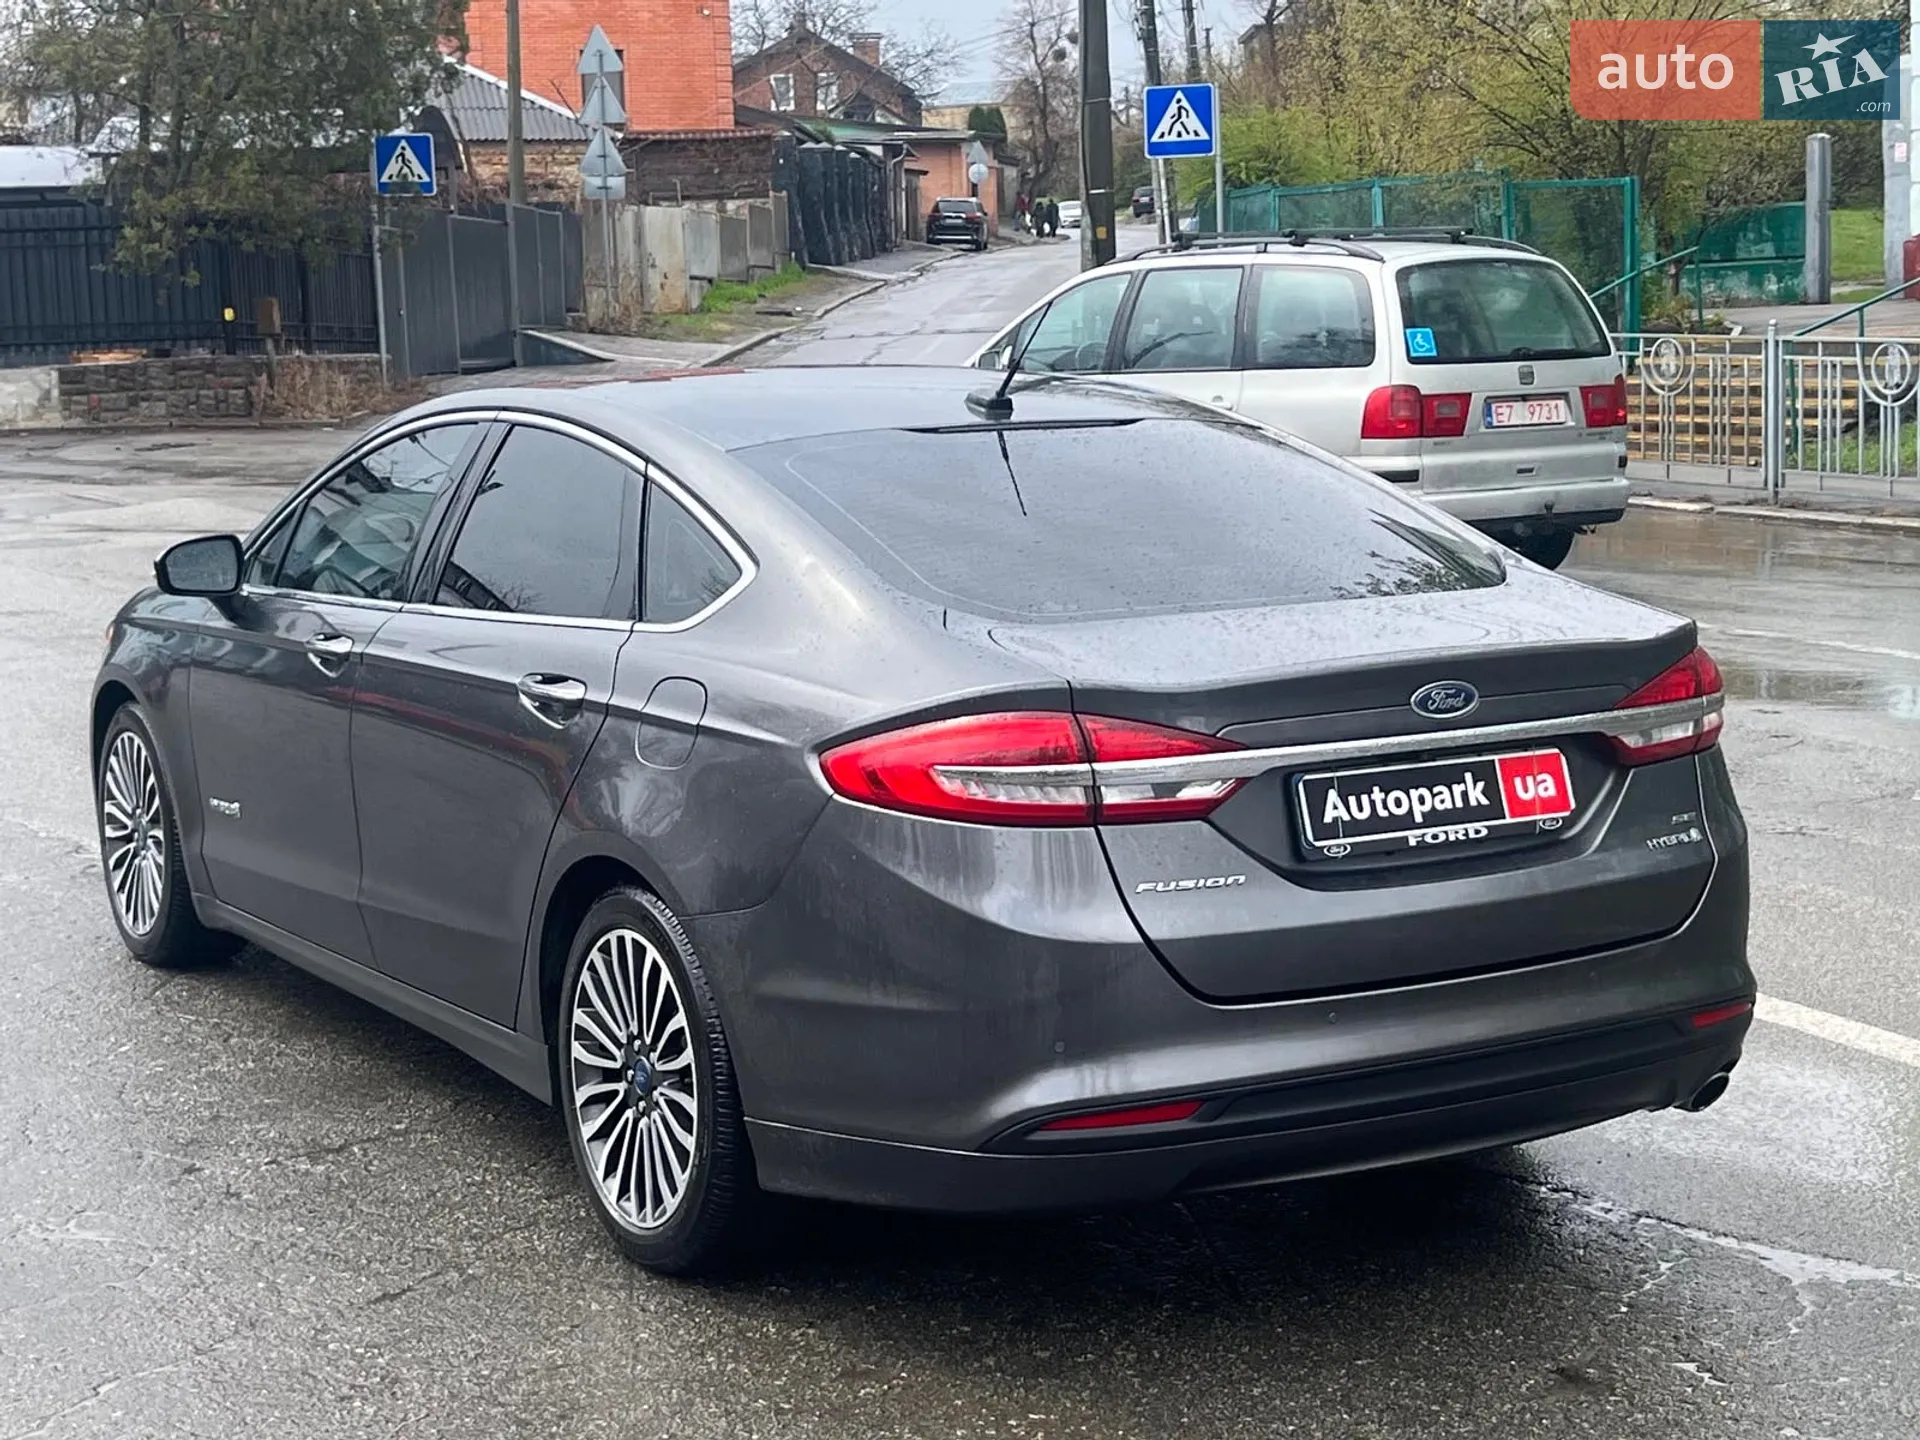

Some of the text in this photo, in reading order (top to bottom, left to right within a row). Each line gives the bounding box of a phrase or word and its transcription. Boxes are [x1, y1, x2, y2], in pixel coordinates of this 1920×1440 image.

[1494, 403, 1560, 424] E7 9731
[1427, 688, 1466, 711] Ford
[1323, 771, 1558, 824] Autopark ua
[1407, 826, 1489, 847] FORD
[1135, 875, 1246, 893] FUSION
